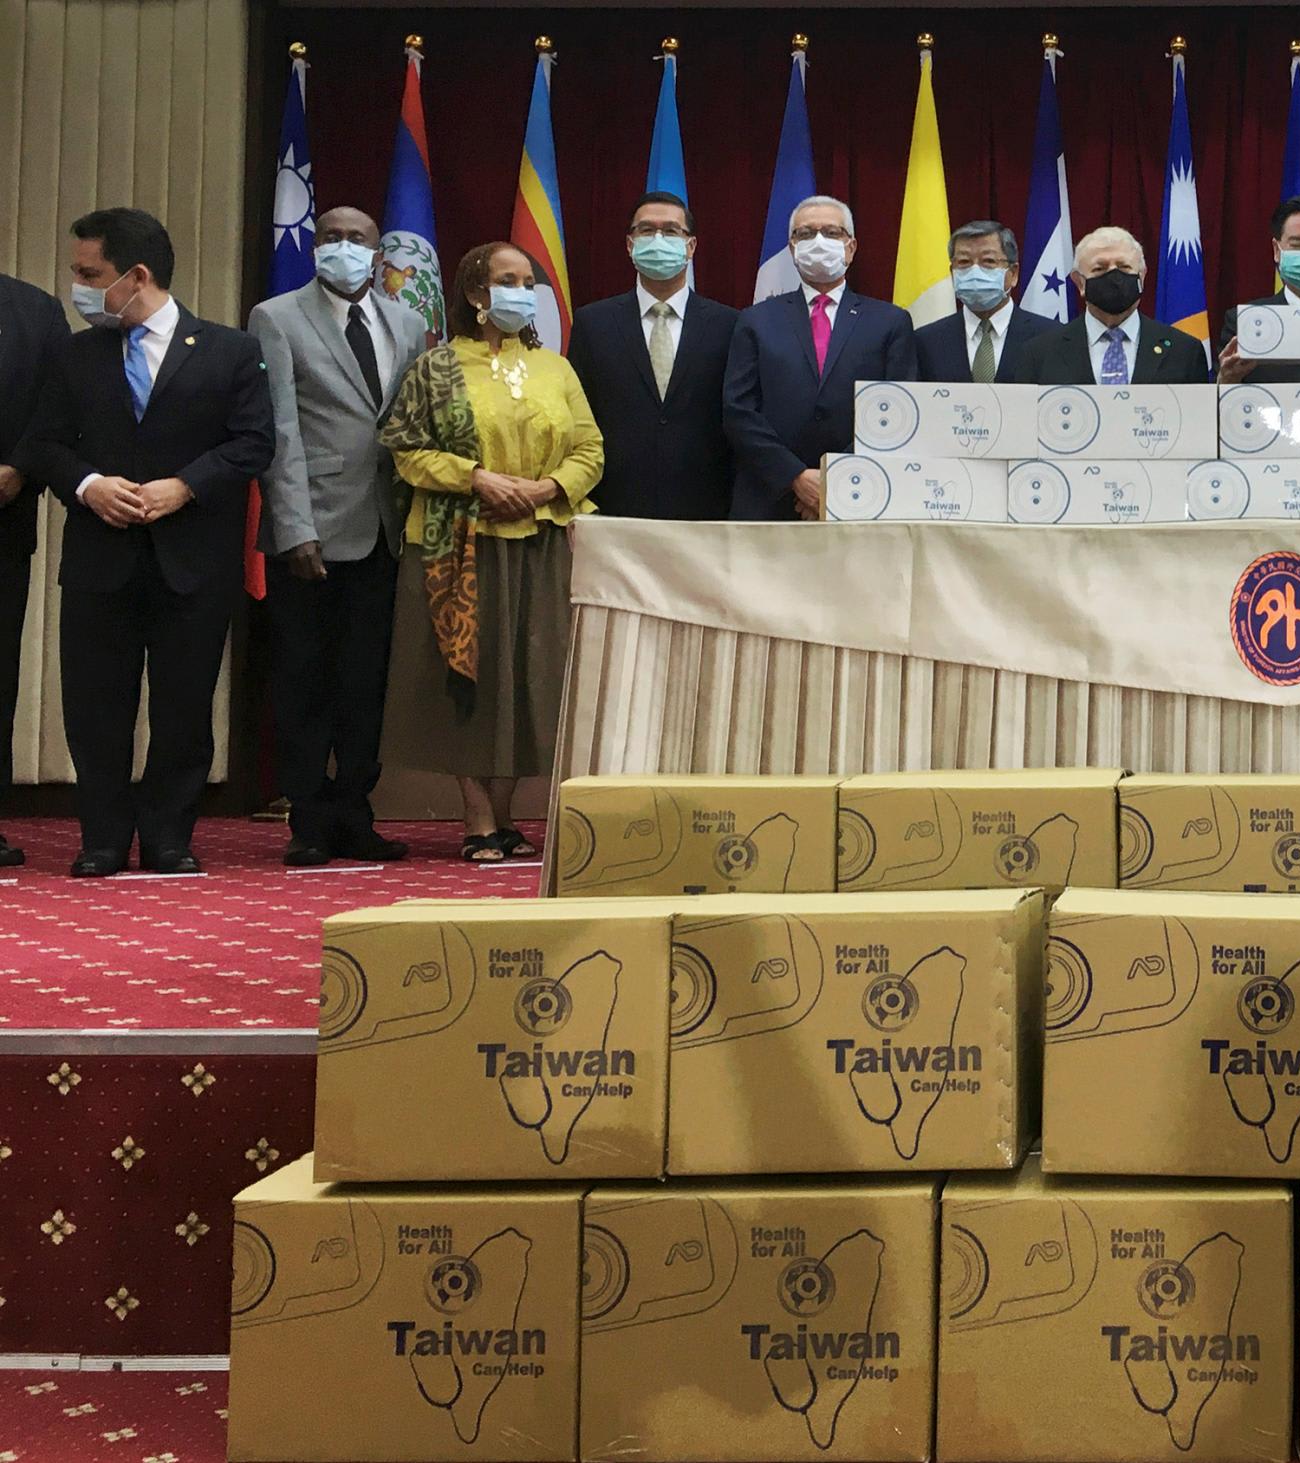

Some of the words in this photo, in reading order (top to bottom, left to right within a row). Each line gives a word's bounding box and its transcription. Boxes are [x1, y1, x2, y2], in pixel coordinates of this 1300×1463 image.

[952, 426, 989, 436] Taiwan
[1132, 428, 1169, 436] Taiwan
[924, 501, 960, 510] Taiwan
[1103, 504, 1139, 512] Taiwan
[692, 809, 736, 822] Health
[972, 810, 1016, 822] Health
[1250, 809, 1293, 820] Health
[692, 822, 712, 834] for
[716, 822, 735, 834] All
[972, 823, 993, 834] for
[996, 823, 1016, 834] All
[1250, 821, 1270, 831] for
[1274, 821, 1294, 832] All
[489, 949, 543, 962] Health
[836, 945, 889, 958] Health
[1212, 946, 1265, 960] Health
[489, 964, 513, 977] for
[518, 964, 543, 977] All
[836, 960, 860, 973] for
[865, 960, 889, 973] All
[1212, 960, 1236, 974] for
[1241, 962, 1265, 975] All
[477, 1043, 635, 1077] Taiwan
[826, 1039, 982, 1073] Taiwan
[562, 1083, 589, 1097] Can
[597, 1083, 632, 1098] Help
[910, 1079, 937, 1093] Can
[945, 1079, 980, 1093] Help
[398, 1226, 453, 1239] Health
[751, 1228, 805, 1241] Health
[1111, 1229, 1166, 1243] Health
[398, 1241, 422, 1254] for
[427, 1241, 452, 1255] All
[751, 1243, 776, 1257] for
[781, 1243, 806, 1257] All
[1111, 1244, 1136, 1258] for
[1141, 1245, 1166, 1259] All
[387, 1321, 546, 1357] Taiwan
[741, 1324, 900, 1360] Taiwan
[1101, 1326, 1260, 1363] Taiwan
[472, 1363, 499, 1376] Can
[508, 1362, 544, 1378] Help
[827, 1366, 854, 1380] Can
[862, 1366, 898, 1381] Help
[1187, 1368, 1214, 1382] Can
[1223, 1368, 1258, 1384] Help
